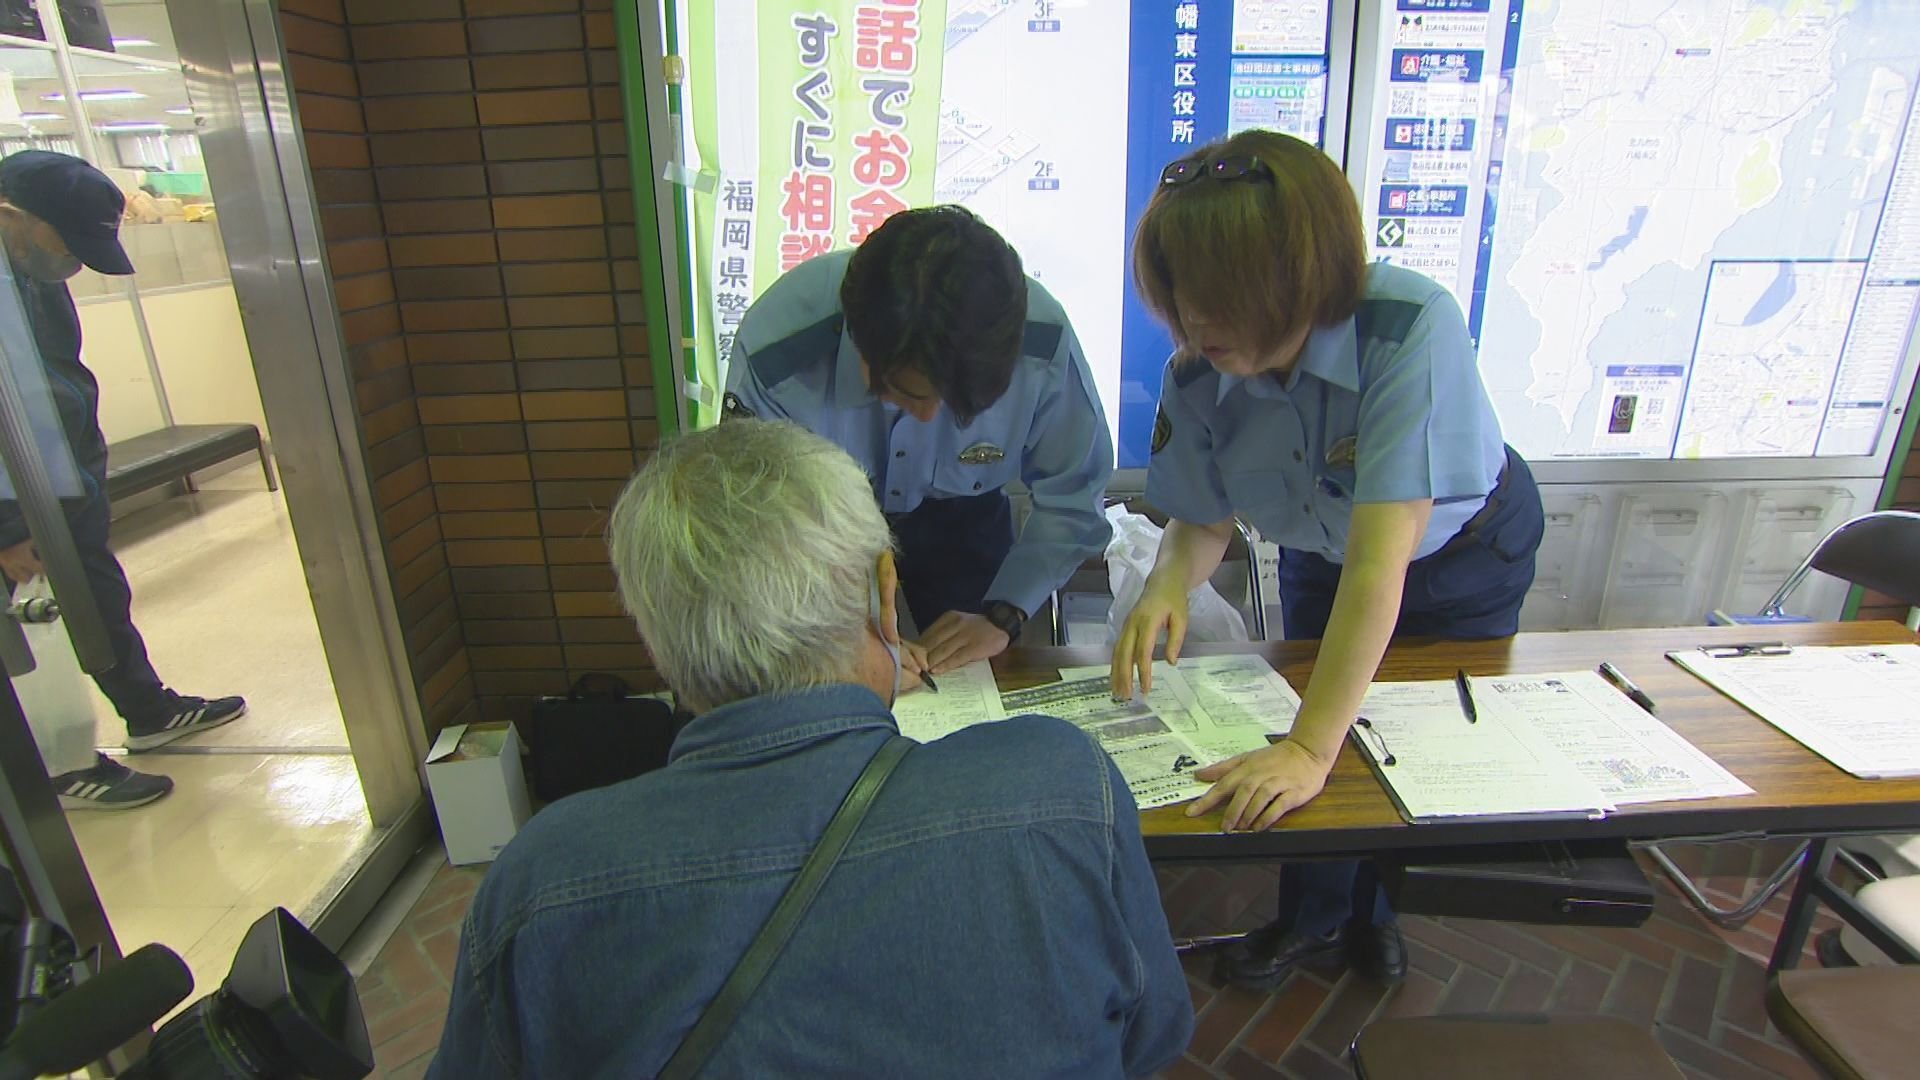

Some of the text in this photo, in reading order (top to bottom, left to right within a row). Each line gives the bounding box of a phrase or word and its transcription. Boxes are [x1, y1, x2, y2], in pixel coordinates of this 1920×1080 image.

[1034, 0, 1055, 19] 3F
[1171, 0, 1199, 144] 幡東区役所
[850, 0, 917, 245] 話でお金
[1034, 160, 1054, 177] 2F
